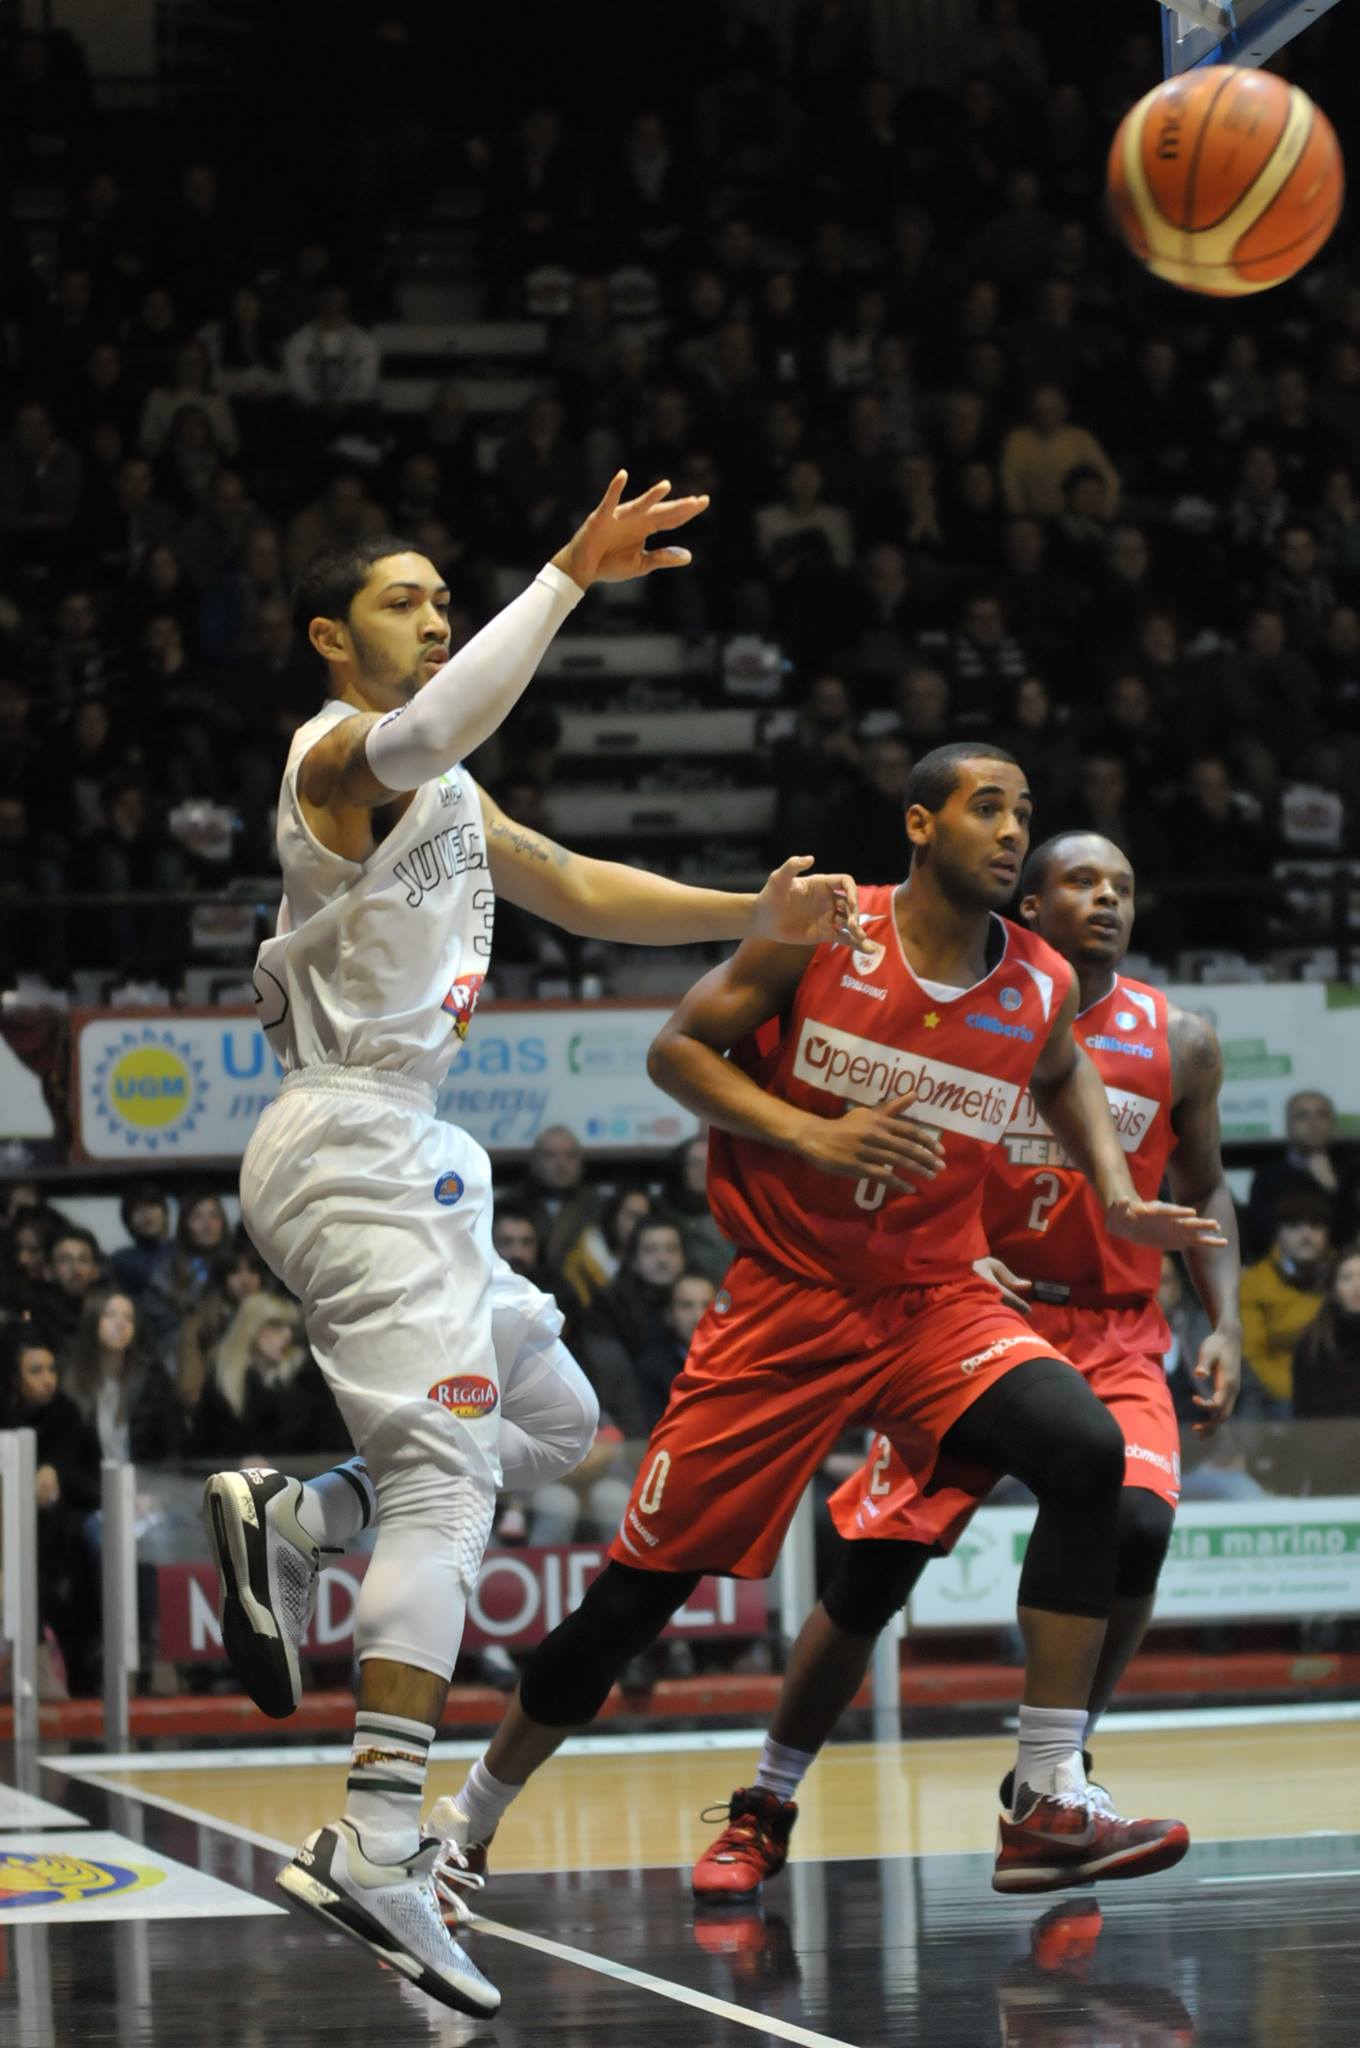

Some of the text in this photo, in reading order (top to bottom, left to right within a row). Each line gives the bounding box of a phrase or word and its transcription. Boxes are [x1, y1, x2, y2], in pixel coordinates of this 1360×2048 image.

[393, 823, 484, 908] JUVEC
[115, 1075, 186, 1100] UGM
[1028, 1173, 1060, 1232] 2
[438, 1384, 495, 1404] REGGIA
[638, 1449, 671, 1515] 0
[870, 1434, 891, 1497] 2
